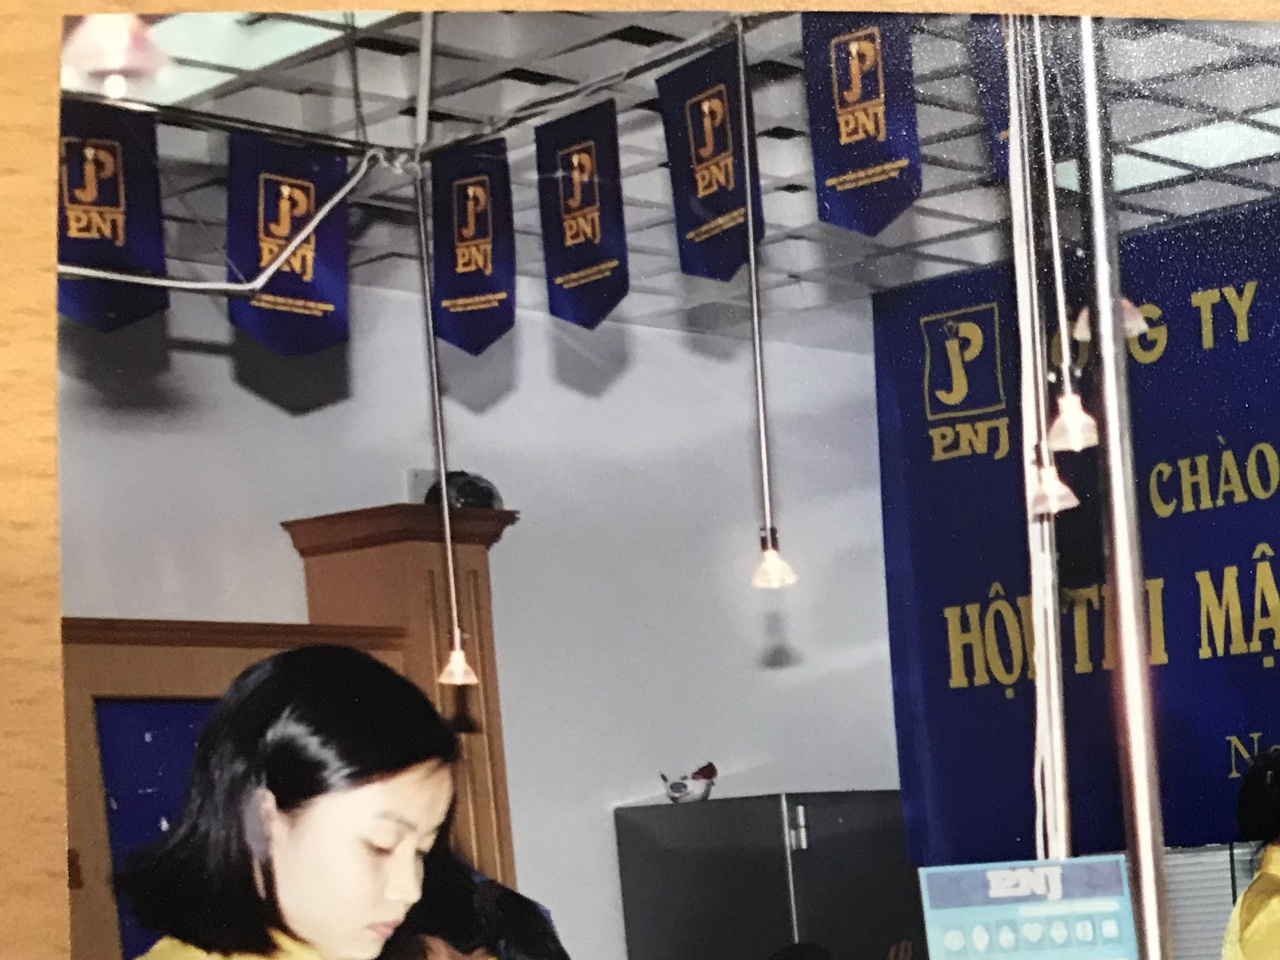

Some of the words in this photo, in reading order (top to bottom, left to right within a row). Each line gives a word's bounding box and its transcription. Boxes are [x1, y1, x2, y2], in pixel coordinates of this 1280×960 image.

[838, 105, 887, 145] PNJ
[696, 156, 736, 198] PNJ
[66, 210, 126, 248] PNJ
[562, 212, 602, 247] PNJ
[455, 242, 493, 277] PNJ
[1191, 280, 1257, 349] TY
[928, 416, 1010, 462] PNJ
[1149, 436, 1280, 519] CHÀO
[986, 866, 1063, 900] PNJ
